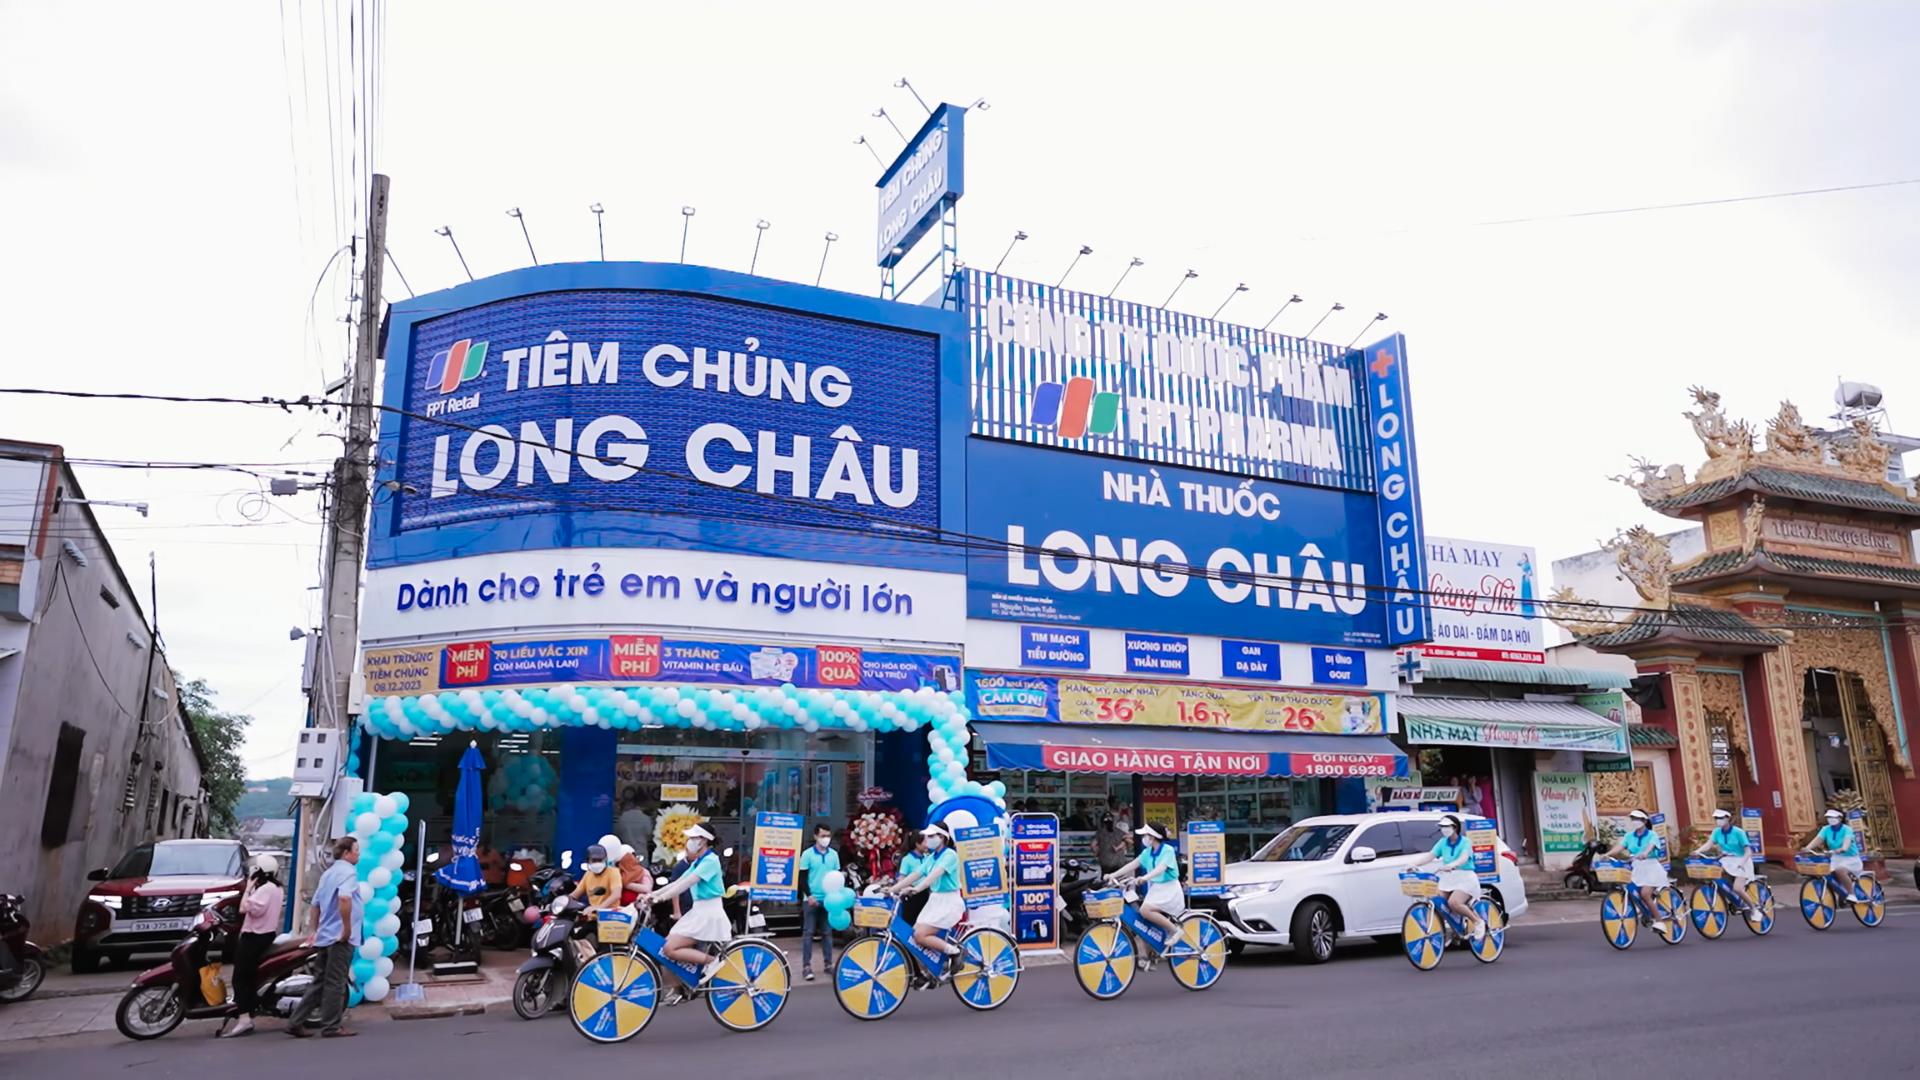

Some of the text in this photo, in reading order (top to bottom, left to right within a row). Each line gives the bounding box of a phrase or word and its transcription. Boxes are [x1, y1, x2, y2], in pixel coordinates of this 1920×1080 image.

[879, 166, 943, 250] LONG CHÂU
[987, 296, 1089, 360] CÔNG
[1101, 321, 1147, 369] TY
[502, 330, 852, 408] TIÊM CHỦNG
[426, 392, 481, 418] FPT Retail
[1128, 396, 1342, 471] FPT PHARMA
[430, 414, 919, 508] LONG CHÂU
[1102, 468, 1281, 521] NHÀ THUỐC
[1376, 383, 1415, 636] LONG CHÂU
[1463, 548, 1502, 568] MAY
[1007, 524, 1366, 616] LONG CHÂU
[397, 562, 913, 616] Dành cho trẻ em và người lớn
[1031, 632, 1080, 646] TIM MẠCH
[1127, 640, 1187, 653] XƯƠNG KHỚP
[451, 643, 485, 662] MIỄN
[493, 650, 508, 661] 70
[566, 646, 588, 656] XIN
[614, 638, 658, 657] MIỄN
[664, 647, 720, 660] 3 THÁNG
[1049, 648, 1085, 662] ĐƯỜNG
[1241, 646, 1261, 656] GAN
[366, 651, 433, 666] KHAI TRƯƠNG
[537, 658, 555, 670] (HÀ
[556, 658, 579, 669] LAN)
[818, 649, 857, 664] 100%
[1134, 654, 1182, 669] THẦN KINH
[1325, 653, 1352, 666] DỊ ỨNG
[370, 664, 429, 679] TIÊM CHỦNG
[455, 662, 479, 678] PHÍ
[621, 657, 651, 673] PHÍ
[663, 661, 707, 671] VITAMIN
[709, 662, 721, 673] MẸ
[821, 664, 856, 681] QUÀ
[863, 660, 880, 671] CHO
[1236, 660, 1268, 673] DẠ DÀY
[1329, 670, 1351, 680] GOUT
[374, 679, 421, 692] 08.12.2023
[1017, 692, 1042, 707] ƠN!
[1177, 700, 1210, 723] 1.6
[1448, 725, 1480, 742] MAY
[1053, 749, 1261, 772] GIAO HÀNG TẬN NƠI
[1312, 753, 1378, 764] GỌI NGAY:
[1305, 764, 1387, 776] 1800 6928
[1559, 776, 1576, 784] MAY
[1143, 788, 1165, 799] DƯỢC
[1423, 790, 1437, 800] HEO
[1437, 790, 1456, 801] QUAY
[971, 867, 994, 878] HPV
[1022, 892, 1051, 904] 100%
